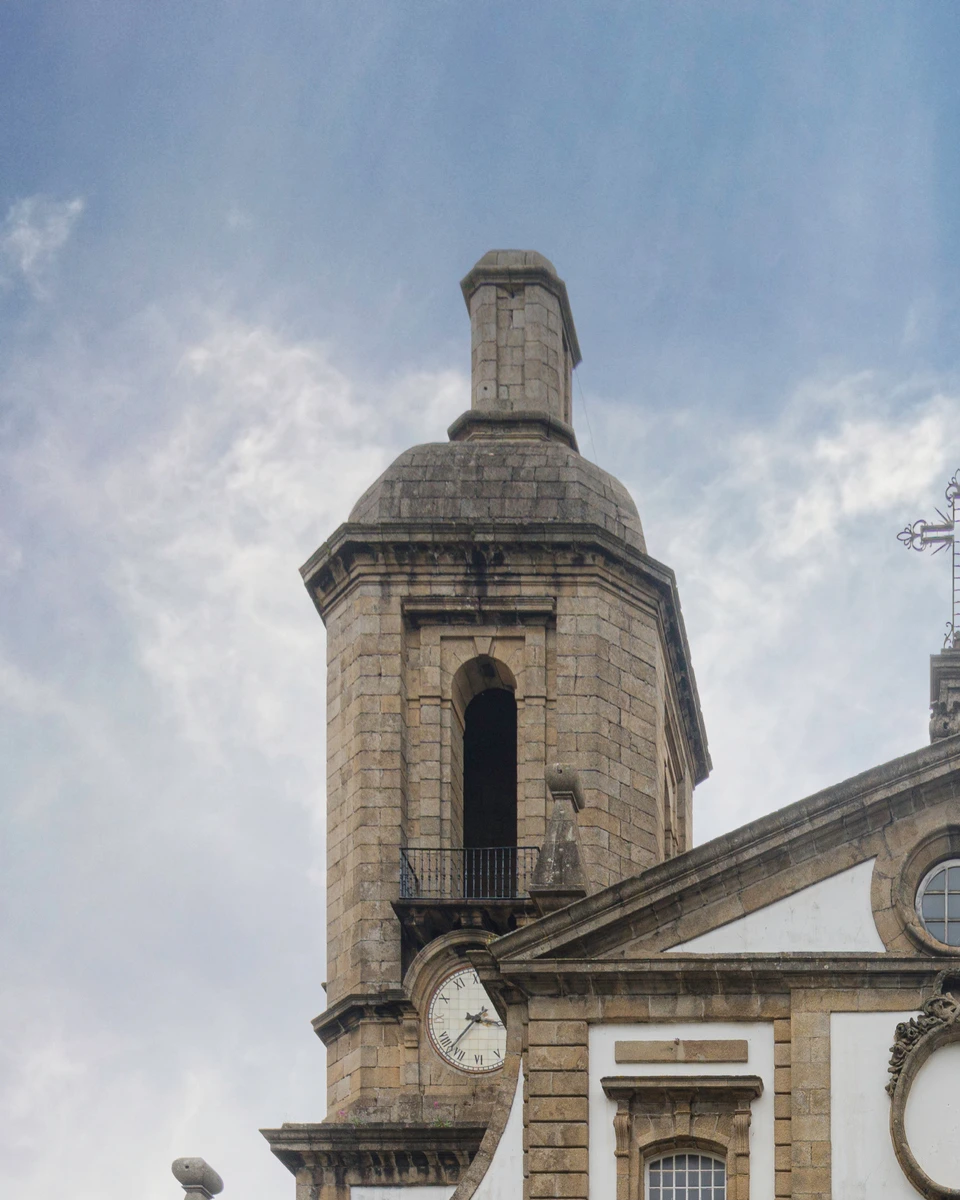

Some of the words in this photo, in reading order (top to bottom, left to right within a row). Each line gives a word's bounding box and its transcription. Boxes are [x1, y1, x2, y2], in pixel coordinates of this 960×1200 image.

[453, 977, 466, 990] XI
[439, 993, 450, 1004] X
[438, 1031, 452, 1048] VIII
[454, 1047, 466, 1061] VII
[474, 1054, 483, 1065] VI
